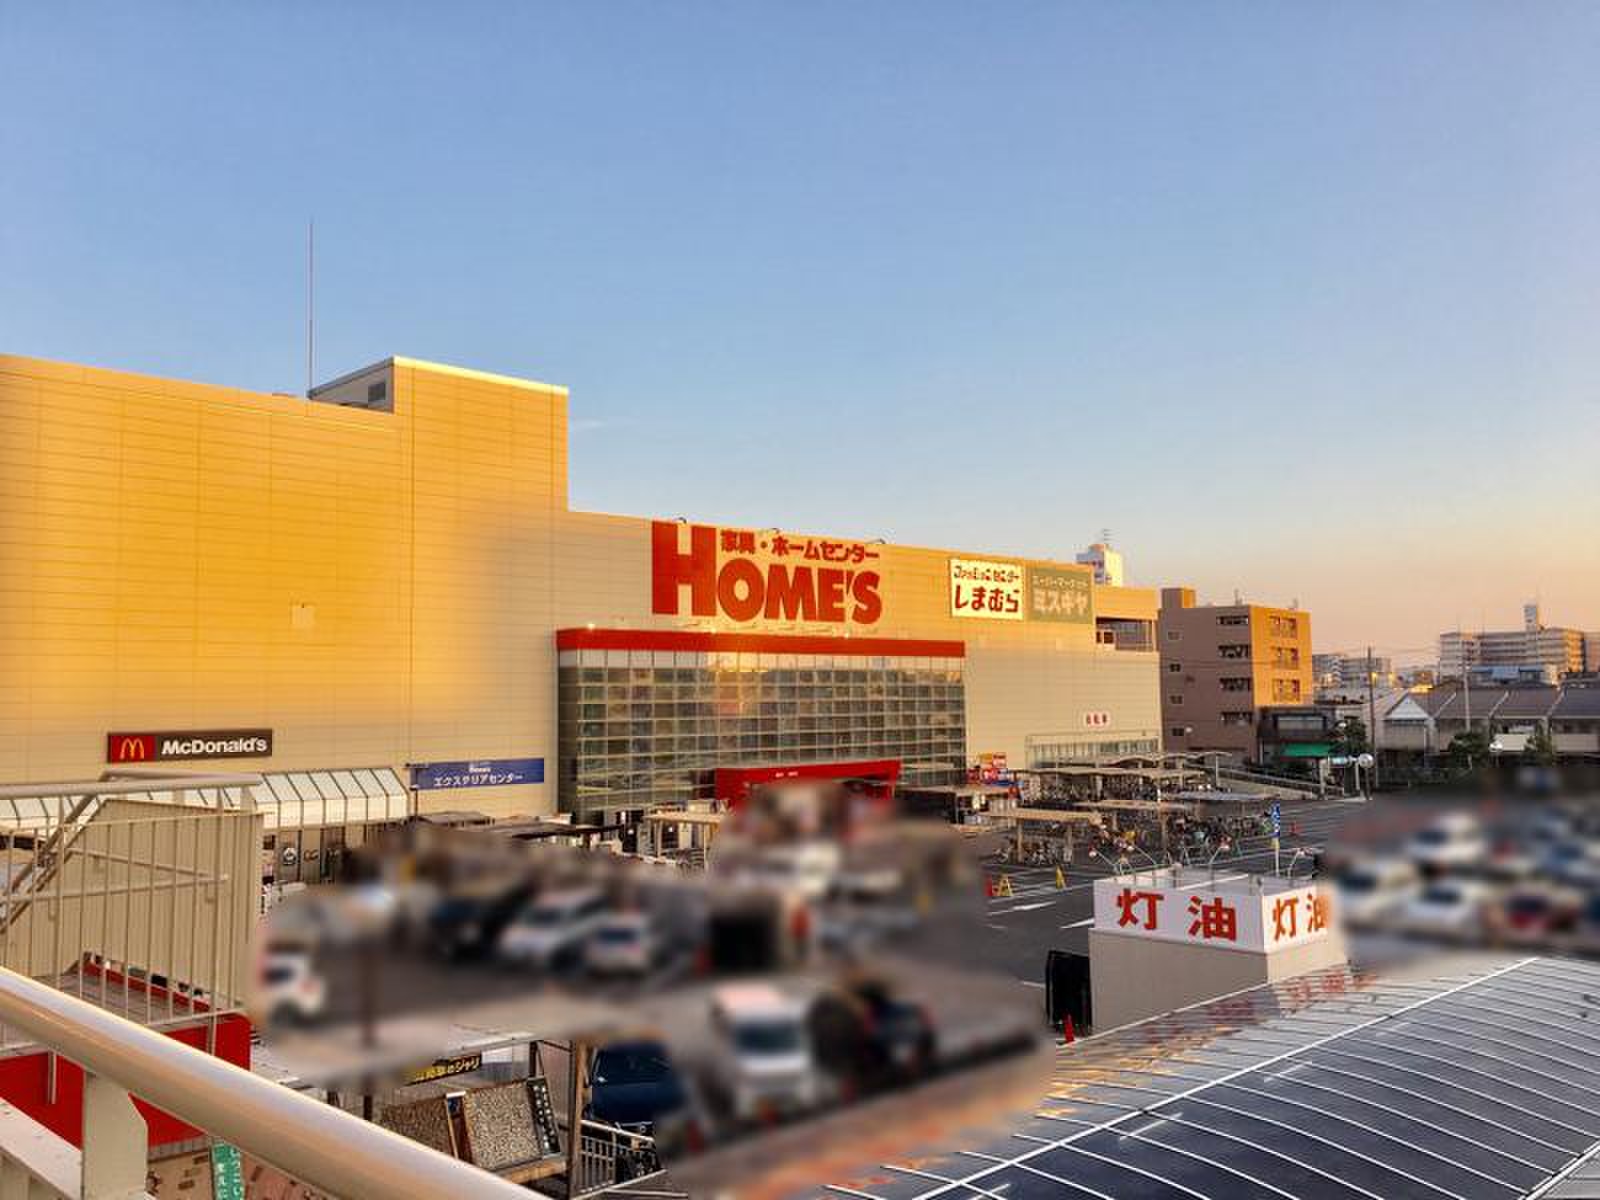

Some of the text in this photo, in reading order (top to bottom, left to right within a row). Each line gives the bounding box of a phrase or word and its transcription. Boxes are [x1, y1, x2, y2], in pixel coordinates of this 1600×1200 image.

[720, 529, 880, 564] 家具・ホームセンター
[651, 520, 883, 625] HOME'S
[954, 584, 1020, 613] しまむら
[160, 737, 268, 756] McDonald's
[1116, 887, 1238, 942] 灯油
